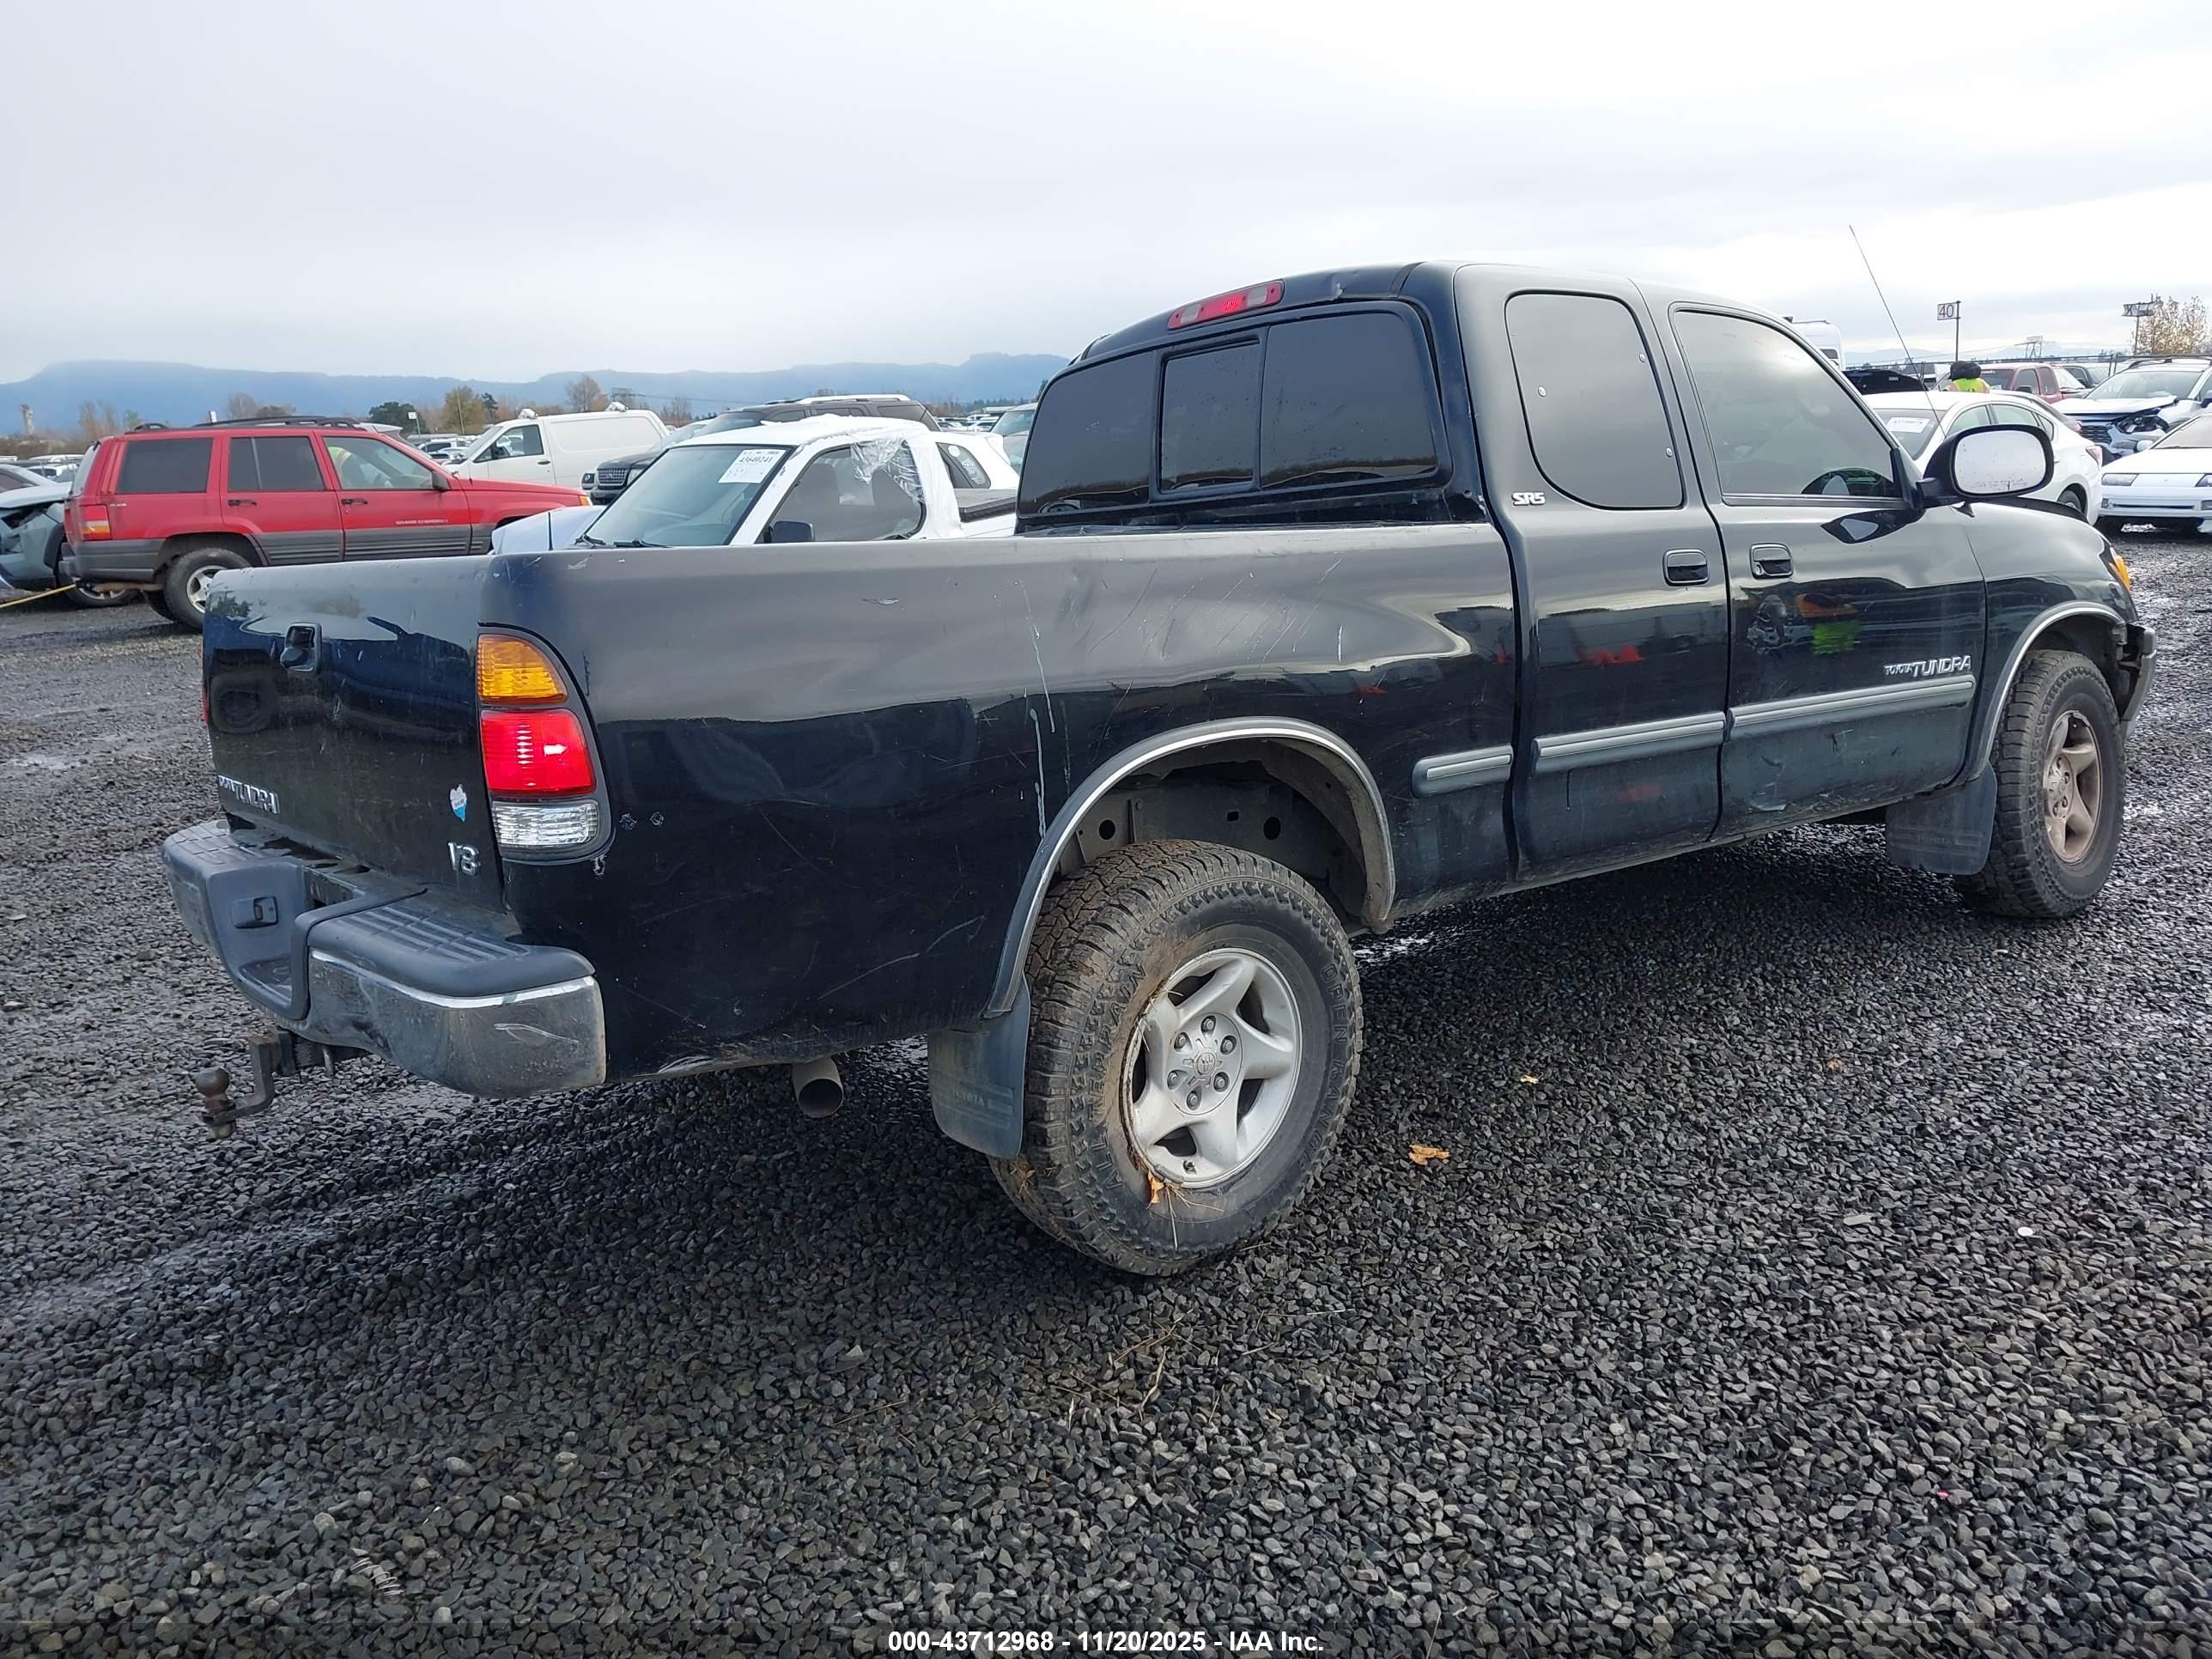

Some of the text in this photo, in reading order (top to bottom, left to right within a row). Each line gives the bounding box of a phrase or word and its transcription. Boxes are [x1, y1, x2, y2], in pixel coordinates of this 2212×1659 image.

[1938, 304, 1954, 318] 40
[1911, 655, 1972, 678] TUNDRA
[233, 780, 281, 814] TUNDRA
[447, 842, 482, 875] V8
